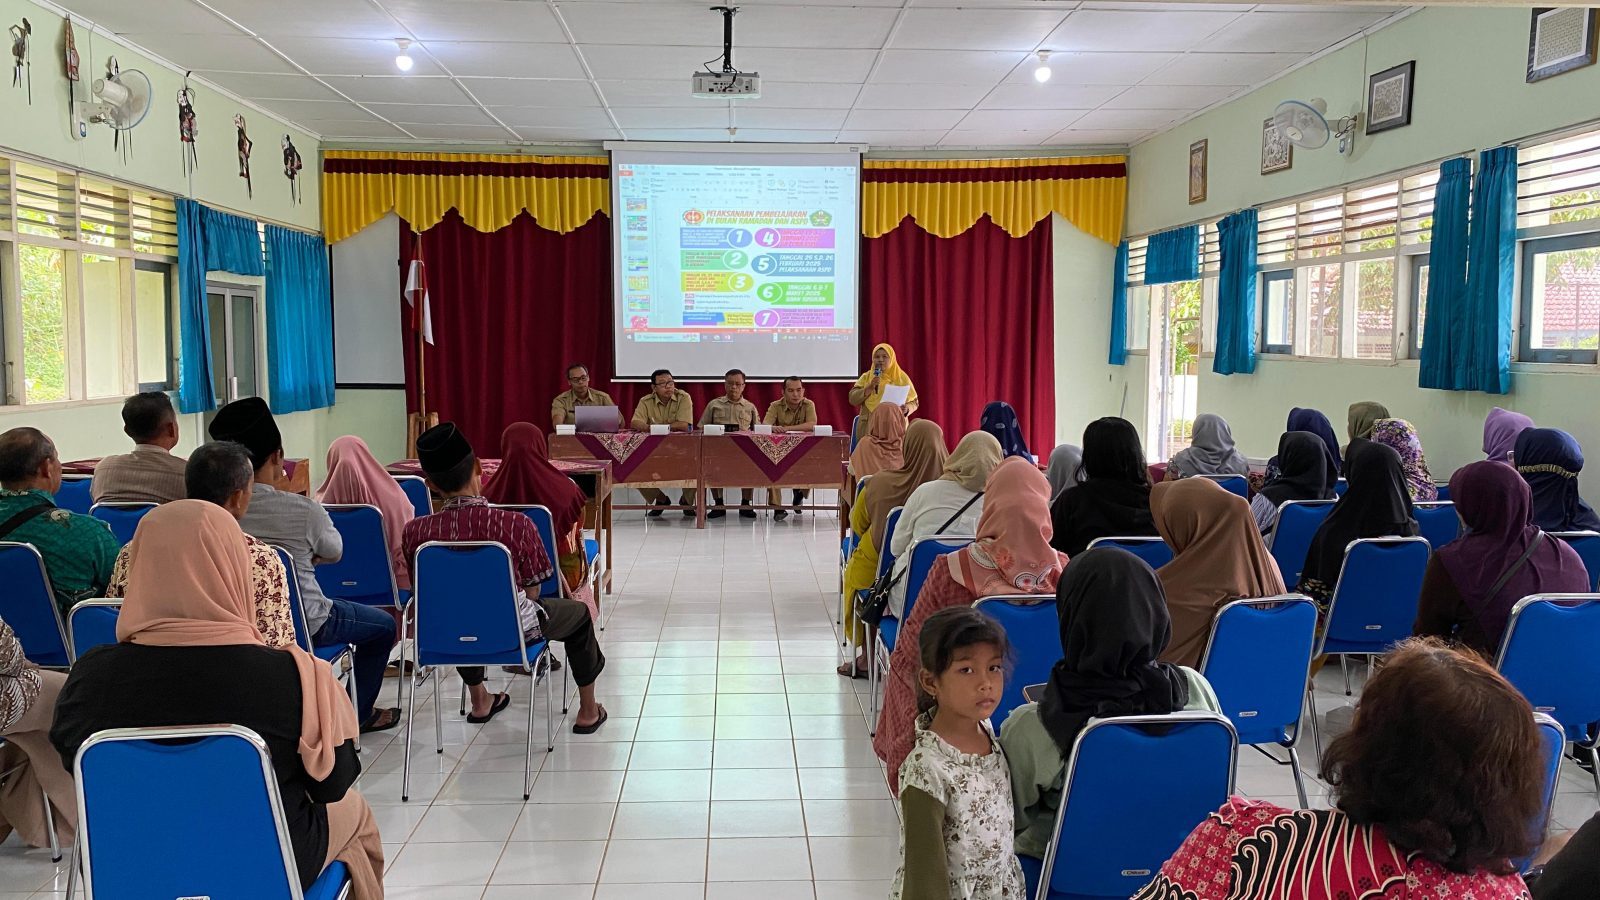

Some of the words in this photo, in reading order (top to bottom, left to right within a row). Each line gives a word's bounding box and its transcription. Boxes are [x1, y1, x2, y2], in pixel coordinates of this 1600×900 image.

[736, 231, 744, 243] 1
[763, 231, 774, 245] 4
[730, 252, 742, 266] 2
[757, 257, 770, 272] 5
[735, 276, 746, 289] 3
[762, 285, 774, 299] 6
